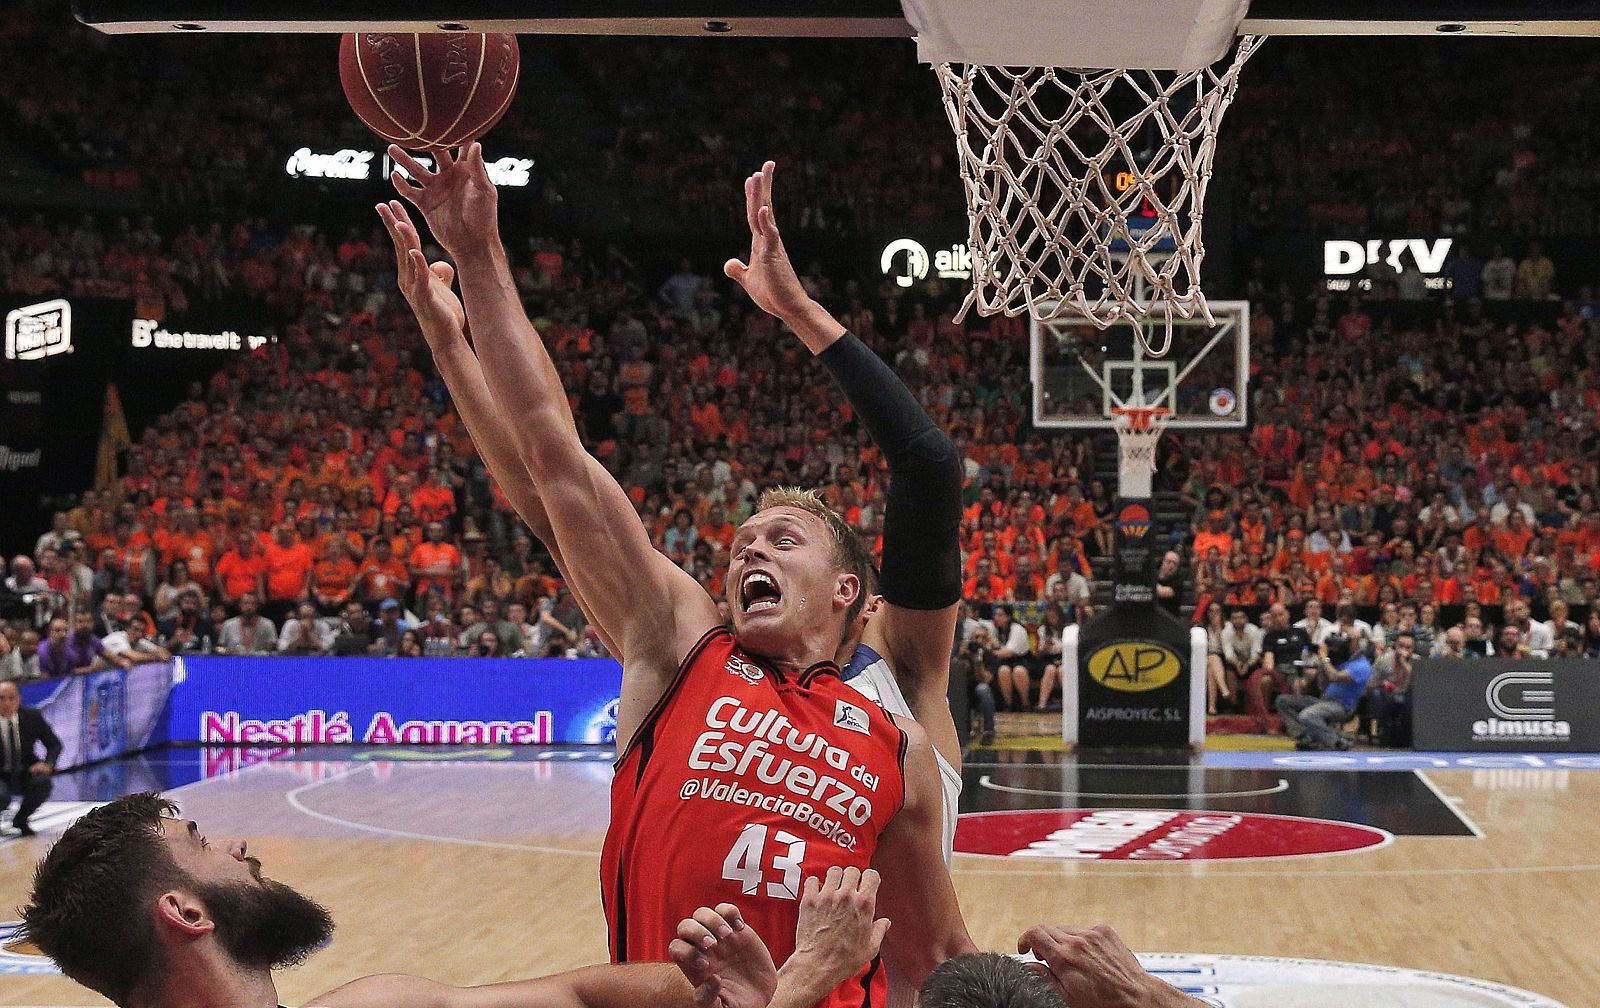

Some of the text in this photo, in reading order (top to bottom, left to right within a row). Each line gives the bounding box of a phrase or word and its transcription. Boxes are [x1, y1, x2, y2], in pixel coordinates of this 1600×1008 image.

[1324, 239, 1452, 274] DKV
[1102, 649, 1166, 682] AP
[200, 710, 353, 744] Nestlé
[705, 696, 880, 793] Cultura del
[1472, 717, 1571, 737] elmusa
[687, 731, 873, 826] Esfuerzo
[679, 777, 858, 853] @ValenciaBasket
[721, 823, 806, 900] 43
